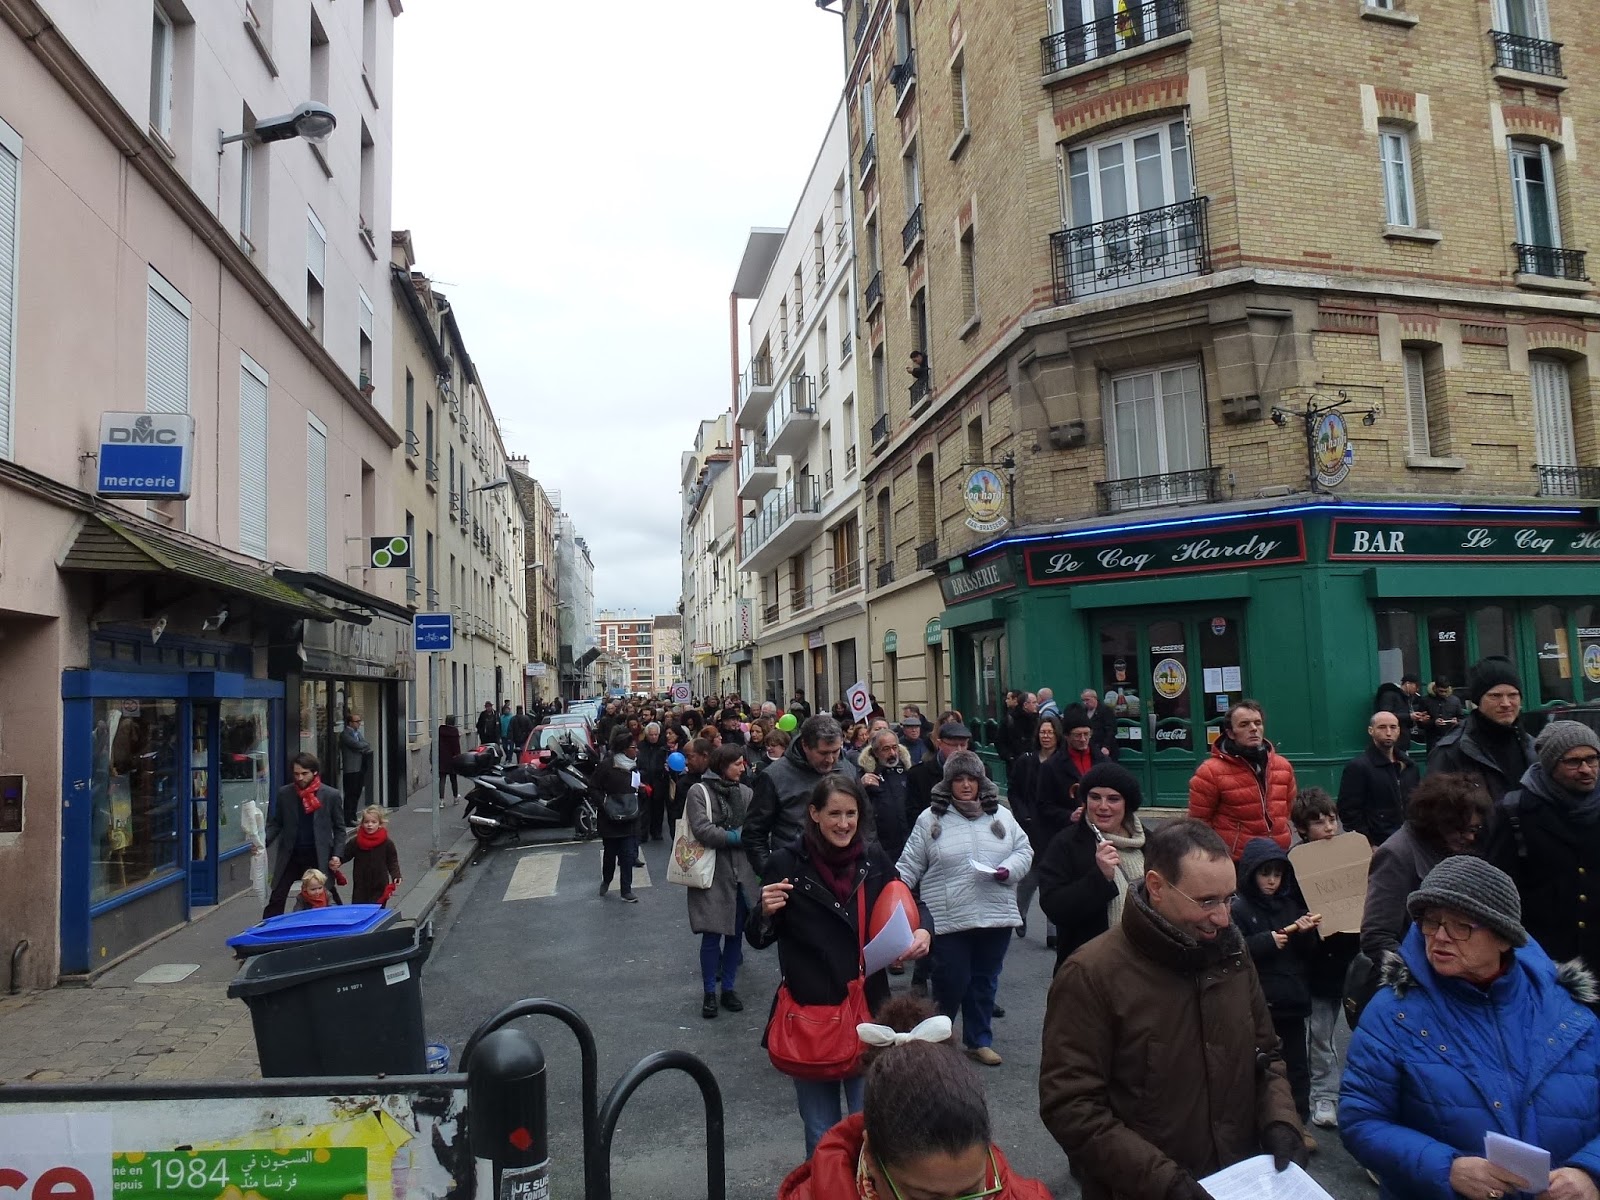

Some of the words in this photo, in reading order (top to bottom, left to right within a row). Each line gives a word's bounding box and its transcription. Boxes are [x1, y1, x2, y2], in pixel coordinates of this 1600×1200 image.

[108, 427, 177, 445] DMC
[103, 475, 176, 488] mercerie
[1352, 530, 1405, 553] BAR
[1461, 528, 1497, 549] Le
[1514, 528, 1555, 553] Coq
[1044, 553, 1084, 574] Le
[1096, 548, 1156, 572] Coq
[1171, 534, 1282, 562] Hardy
[950, 564, 1000, 596] BRASSERIE
[1438, 631, 1456, 640] BAR
[129, 1166, 143, 1176] en
[151, 1157, 230, 1190] 1984
[514, 1181, 531, 1194] JE
